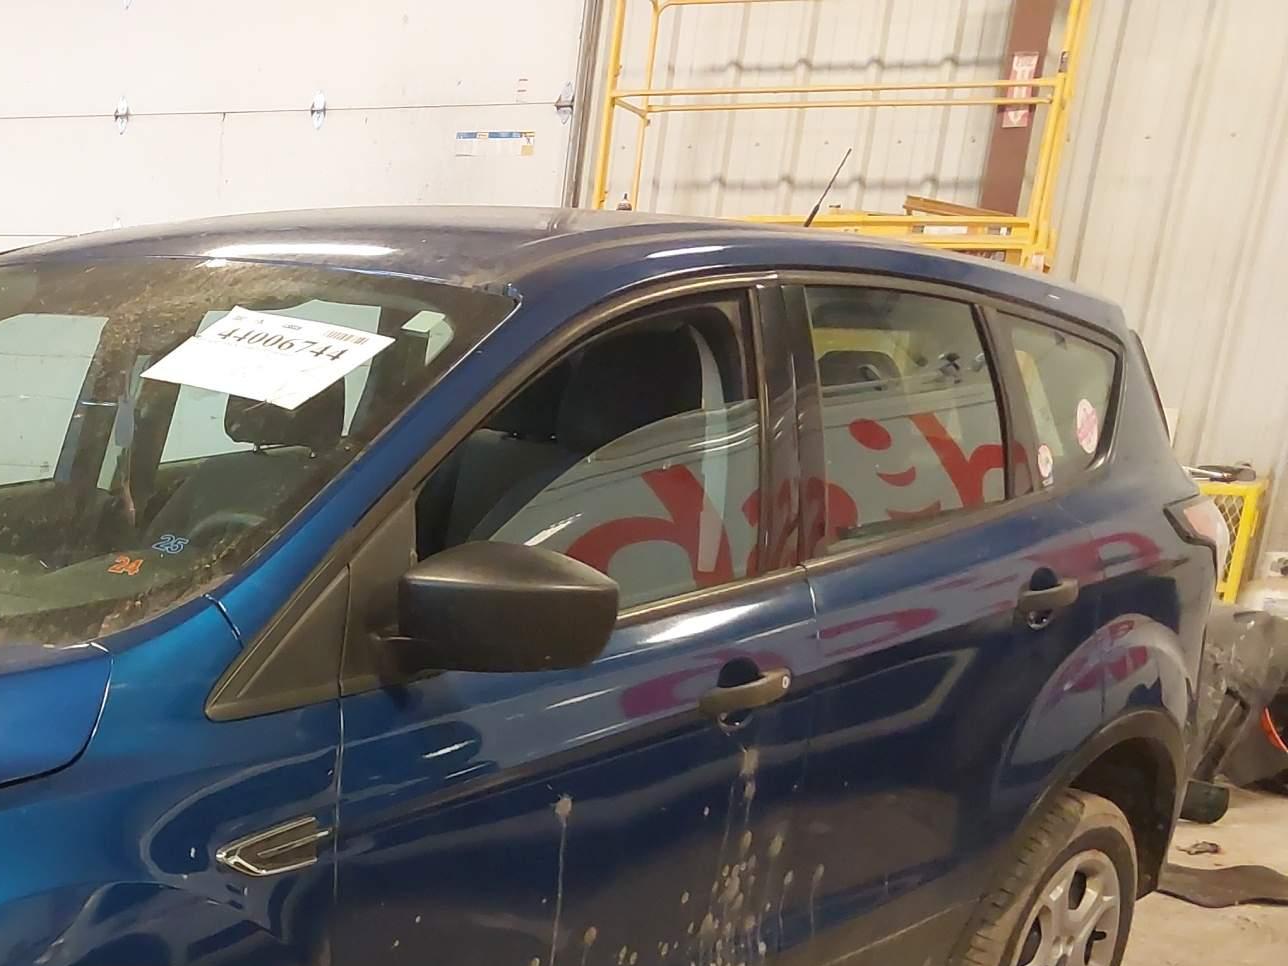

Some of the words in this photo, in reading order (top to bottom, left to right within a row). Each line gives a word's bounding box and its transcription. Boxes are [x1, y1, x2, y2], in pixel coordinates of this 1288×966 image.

[217, 327, 349, 361] 44006744
[152, 534, 189, 554] 25
[107, 555, 144, 576] 24
